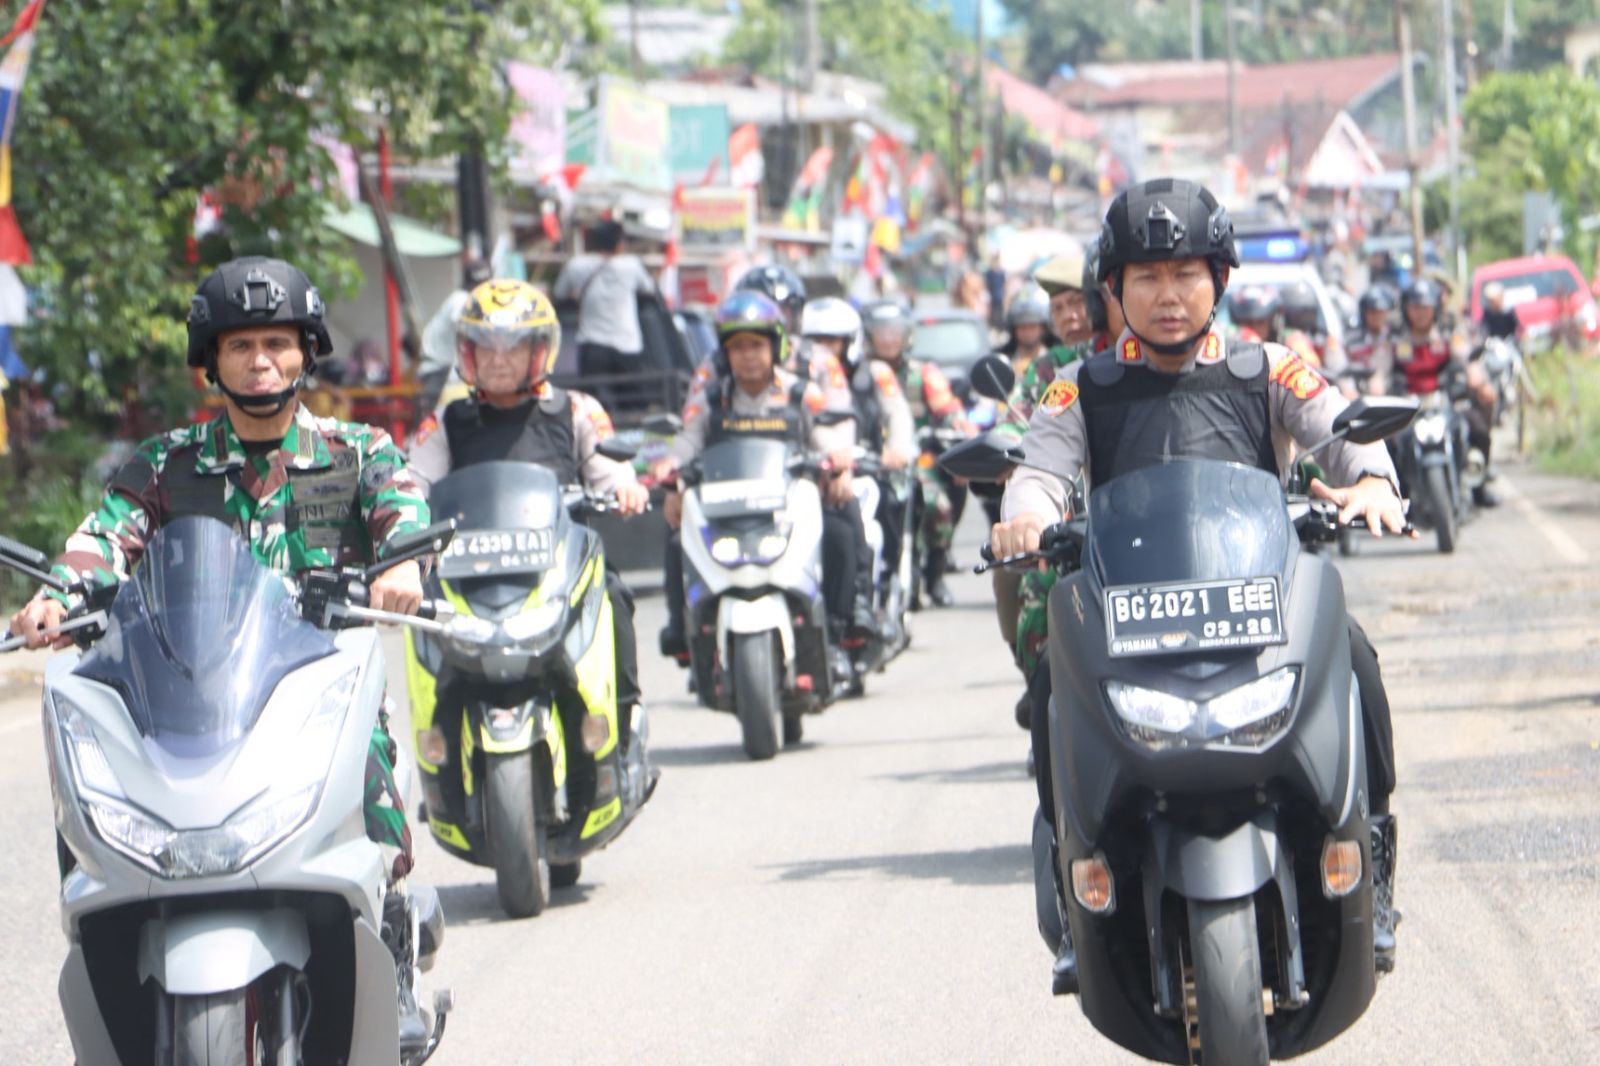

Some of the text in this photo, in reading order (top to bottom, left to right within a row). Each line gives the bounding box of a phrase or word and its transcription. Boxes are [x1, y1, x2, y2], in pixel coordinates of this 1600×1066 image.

[1114, 583, 1274, 623] BG 2021 EEE
[1122, 638, 1158, 653] YAMAHA
